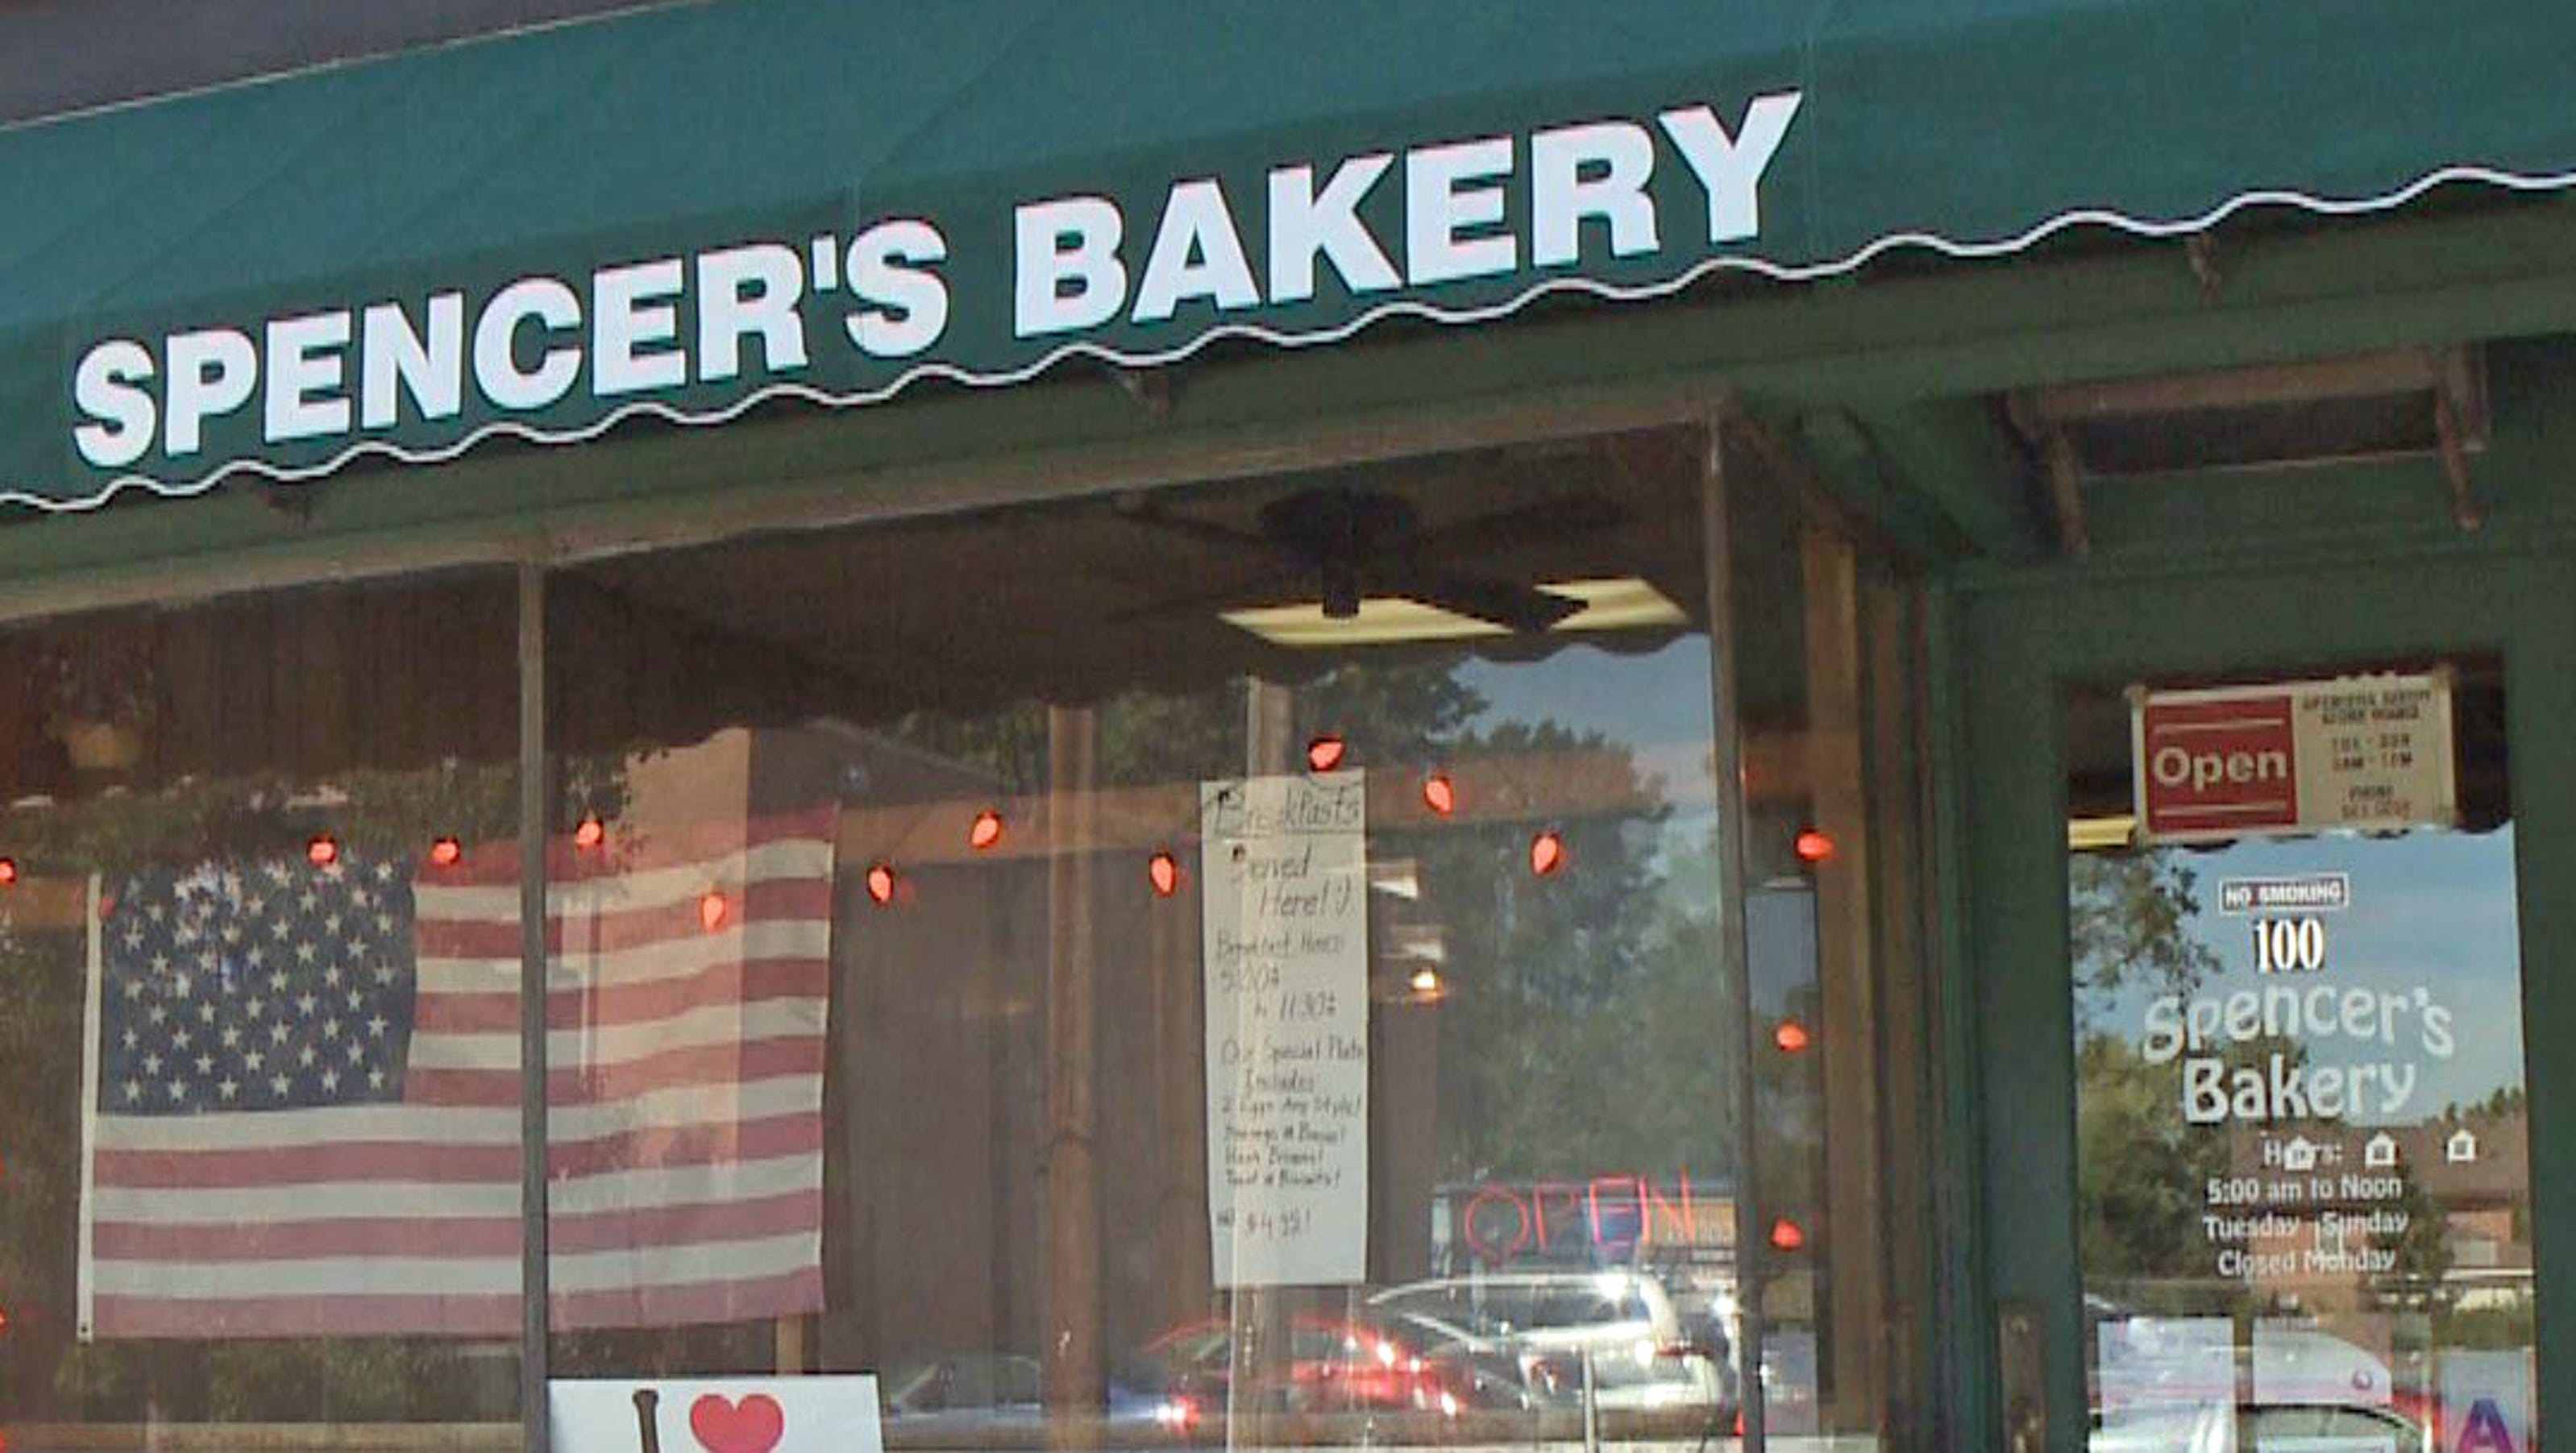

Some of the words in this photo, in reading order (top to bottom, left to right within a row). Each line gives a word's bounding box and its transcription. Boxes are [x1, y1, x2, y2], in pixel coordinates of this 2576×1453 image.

[73, 218, 949, 467] SPENCER'S
[1014, 89, 1802, 337] BAKERY
[2153, 746, 2288, 793] Open
[2225, 886, 2252, 908] NO
[2259, 880, 2341, 907] SMOKING
[2254, 917, 2325, 974] 100
[2143, 983, 2455, 1065] Spencer's
[2183, 1052, 2416, 1123] Bakery
[1463, 1167, 1695, 1264] OPEN
[2207, 1177, 2260, 1206] 5:00
[2266, 1180, 2302, 1205] am
[2311, 1177, 2334, 1200] to
[2341, 1173, 2404, 1201] Noon
[2203, 1210, 2300, 1243] Tuesday
[2320, 1208, 2409, 1239] Sunday
[2217, 1249, 2296, 1277] Closed
[2304, 1246, 2396, 1274] Monday
[2456, 1396, 2515, 1453] A
